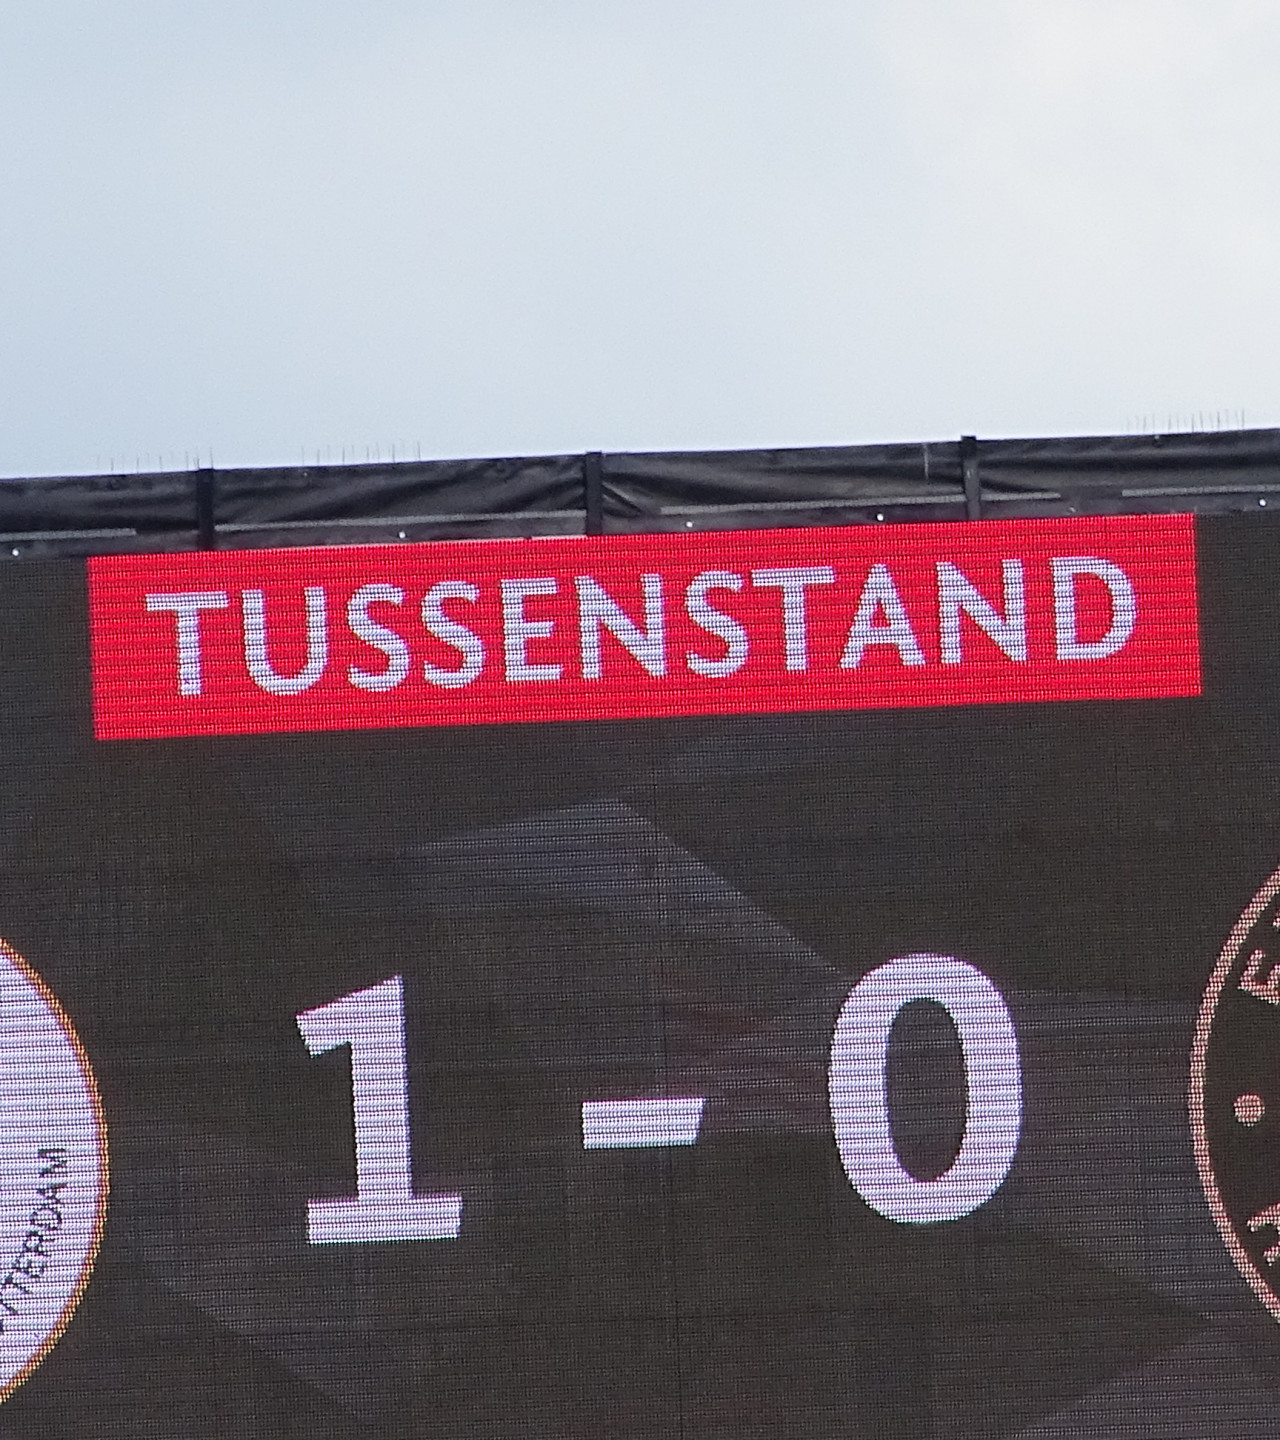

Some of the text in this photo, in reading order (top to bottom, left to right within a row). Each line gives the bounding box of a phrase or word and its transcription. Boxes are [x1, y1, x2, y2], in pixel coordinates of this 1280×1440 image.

[144, 554, 1140, 698] TUSSENSTAND
[295, 951, 1024, 1245] 1 - 0
